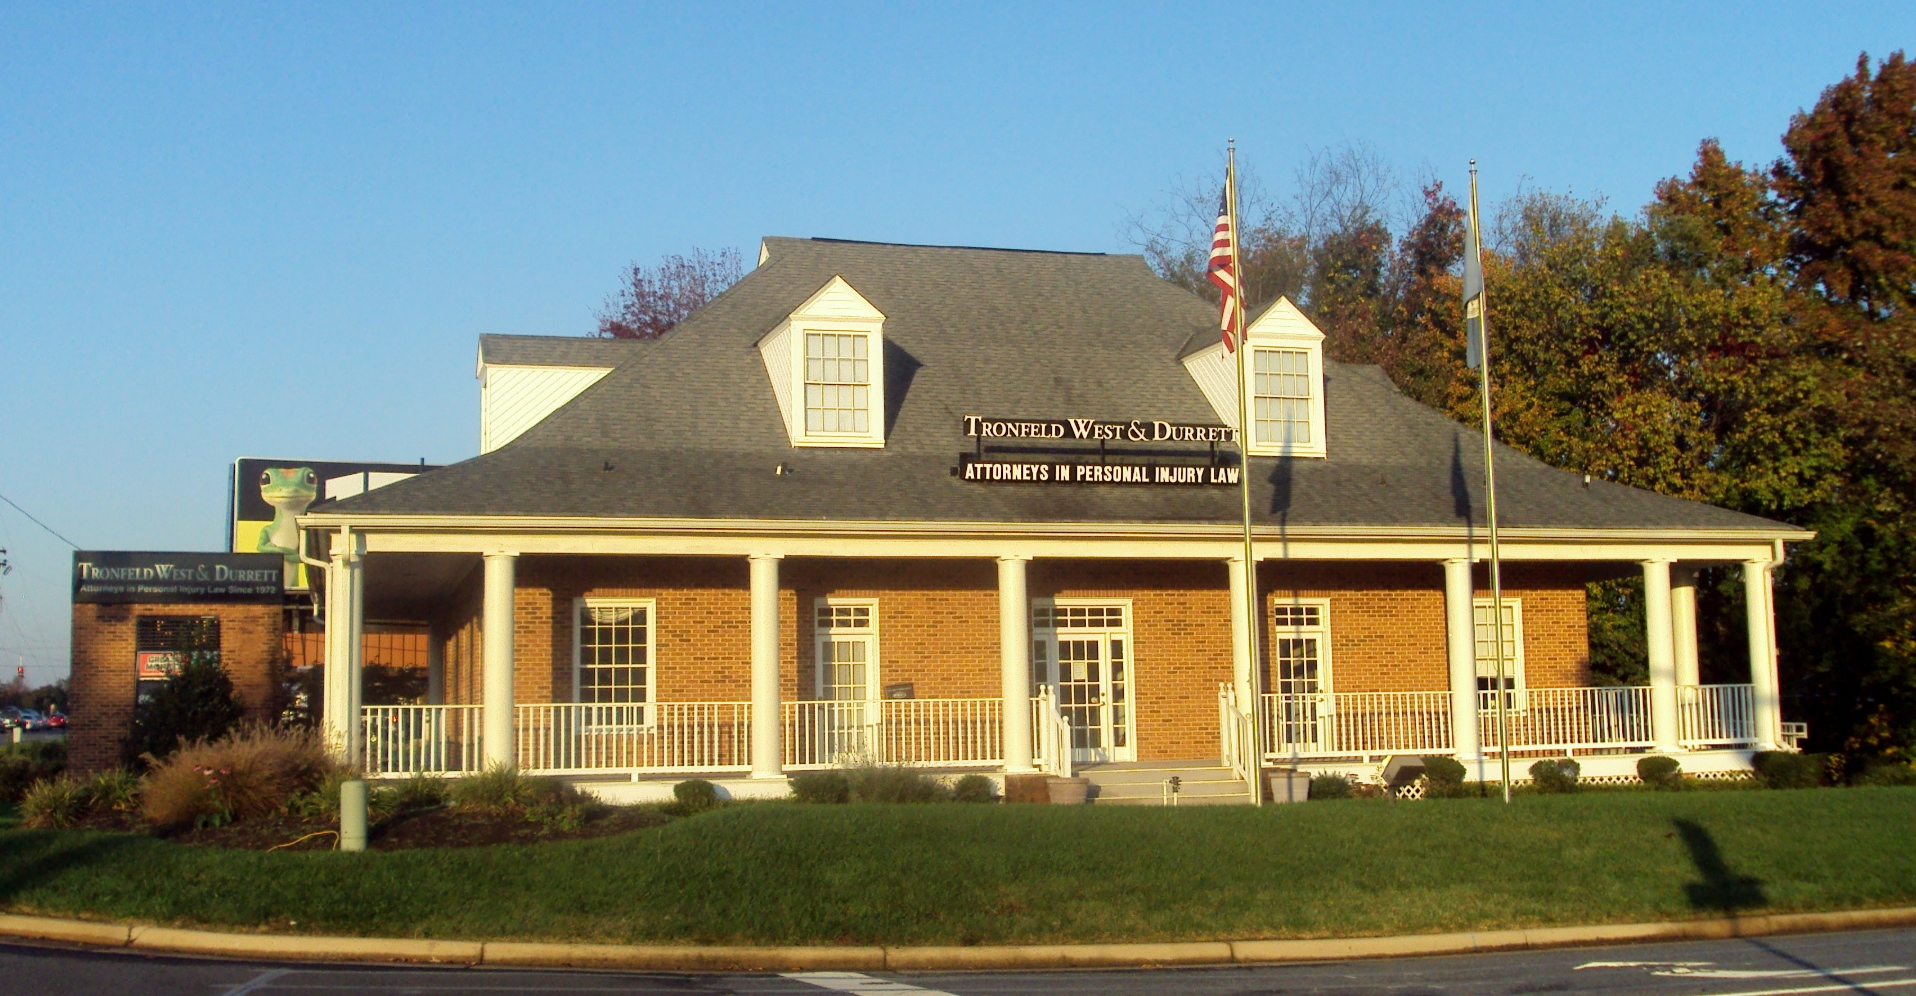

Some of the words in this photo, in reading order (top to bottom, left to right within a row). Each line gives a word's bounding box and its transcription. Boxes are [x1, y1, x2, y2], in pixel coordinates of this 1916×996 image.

[964, 415, 1065, 438] TRONFELD
[1067, 418, 1125, 440] WEST
[1128, 420, 1150, 442] &
[1152, 421, 1239, 442] DURRETT
[965, 463, 1049, 480] ATTORNEYS
[1055, 464, 1070, 481] IN
[1076, 465, 1149, 482] PERSONAL
[1155, 466, 1205, 483] INJURY
[1210, 467, 1239, 484] LAW
[78, 562, 154, 580] TRONFELD
[154, 564, 195, 581] WEST
[195, 564, 210, 581] &
[215, 565, 278, 582] DURRETT
[80, 584, 125, 594] Attorneys
[127, 585, 136, 593] in
[137, 585, 178, 593] Personal
[179, 585, 206, 595] Injury
[207, 586, 226, 594] Law
[228, 586, 253, 594] Since
[256, 586, 276, 594] 1972
